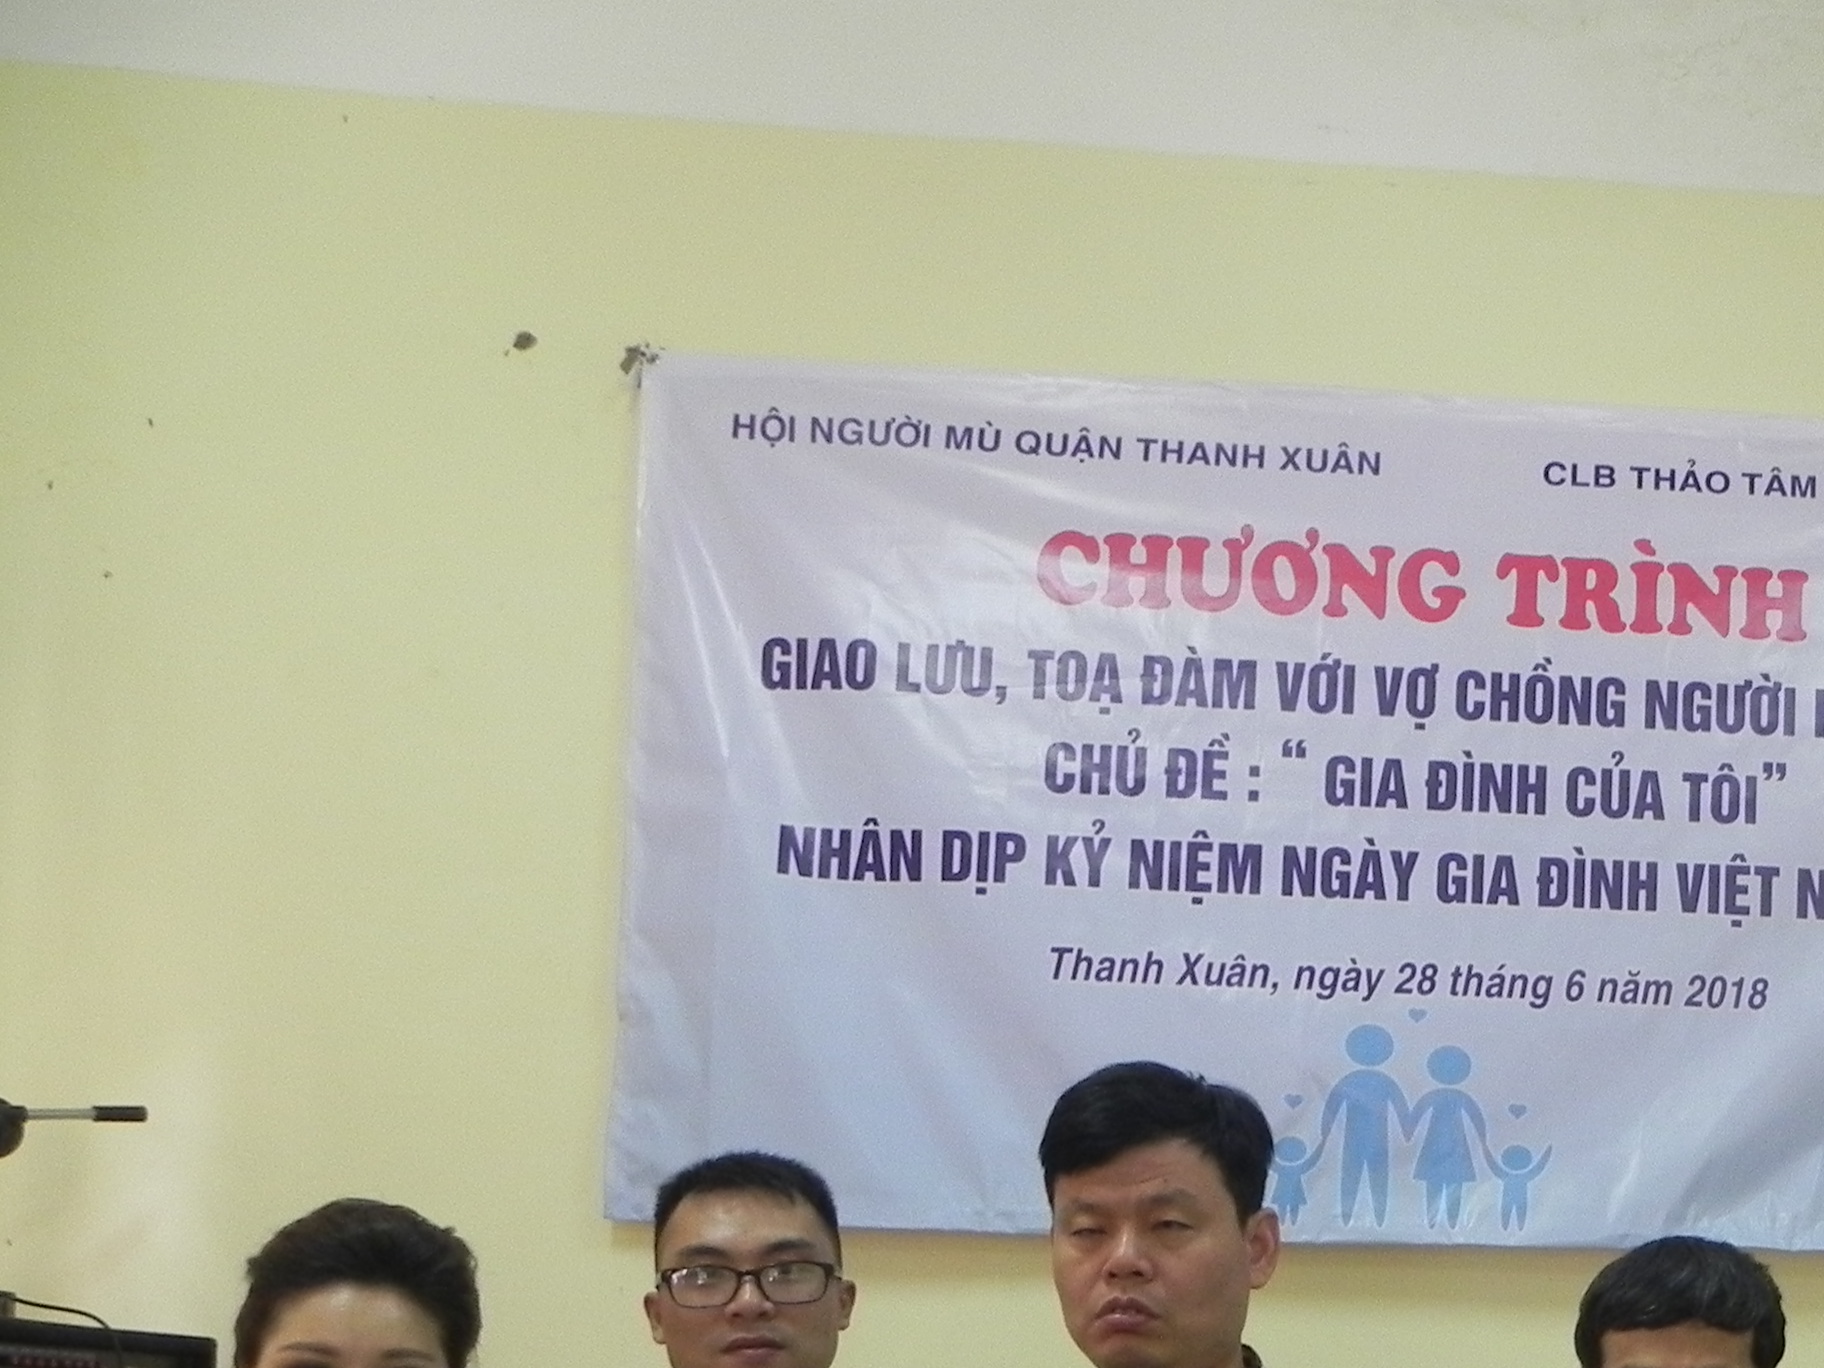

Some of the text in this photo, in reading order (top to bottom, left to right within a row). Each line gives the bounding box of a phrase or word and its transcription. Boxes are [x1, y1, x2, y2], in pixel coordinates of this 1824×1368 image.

[731, 406, 1381, 476] HỘI NGƯỜI MÙ QUẬN THANH XUÂN
[1543, 461, 1616, 489] CLB
[1629, 458, 1731, 495] THẢO
[1741, 466, 1817, 499] TÂM
[1038, 524, 1809, 643] CHƯƠNG TRÌNH
[761, 636, 877, 691] GIAO
[896, 639, 1007, 705] LƯU,
[1027, 649, 1123, 715] TOẠ
[1140, 646, 1257, 710] ĐÀM
[1275, 652, 1356, 715] VỚI
[1374, 663, 1440, 731] VỢ
[1455, 657, 1626, 728] CHỒNG
[1644, 673, 1796, 737] NGƯỜI
[1044, 728, 1147, 797] CHỦ
[1164, 733, 1230, 801] ĐỀ
[1325, 755, 1408, 809] GIA
[1425, 750, 1547, 816] ĐÌNH
[1566, 750, 1665, 821] CỦA
[1682, 761, 1787, 825] TÔI”
[776, 817, 923, 882] NHÂN
[941, 829, 1027, 895] DỊP
[1045, 819, 1112, 888] KỶ
[1128, 830, 1263, 905] NIỆM
[1281, 837, 1419, 902] NGÀY
[1436, 852, 1520, 906] GIA
[1536, 846, 1658, 912] ĐÌNH
[1676, 853, 1780, 928] VIỆT
[1050, 947, 1769, 1010] Thanh Xuân, ngày 28 tháng 6 năm 2018
